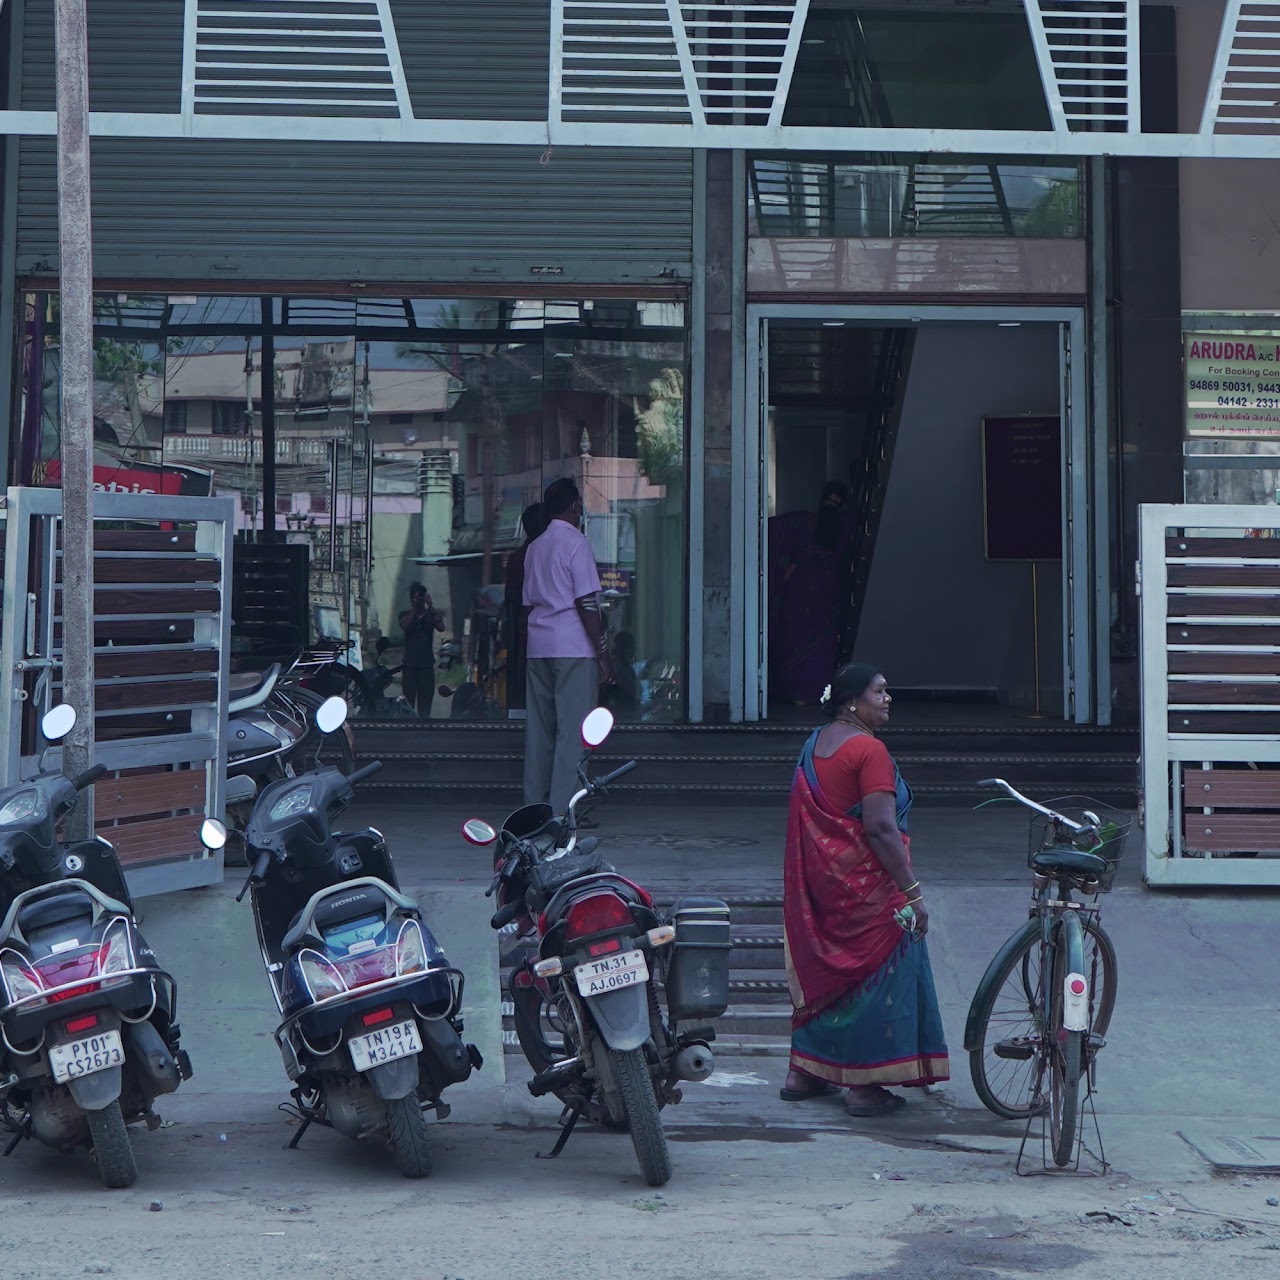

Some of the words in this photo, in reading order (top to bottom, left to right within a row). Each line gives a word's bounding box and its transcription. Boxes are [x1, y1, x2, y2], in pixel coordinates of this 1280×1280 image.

[1189, 340, 1257, 361] ARUDRA
[1258, 352, 1274, 362] A/C
[1208, 366, 1223, 375] For
[1224, 366, 1261, 378] Booking
[1189, 379, 1220, 391] 94869
[1222, 381, 1255, 395] 50031,
[1217, 396, 1247, 407] 04142
[330, 893, 368, 910] HONDA
[591, 955, 628, 974] TN.31
[589, 970, 638, 993] AJ.0697
[72, 1036, 107, 1058] PY01
[363, 1023, 412, 1049] TN19A
[367, 1037, 417, 1065] M3414
[66, 1048, 122, 1077] CS2673
